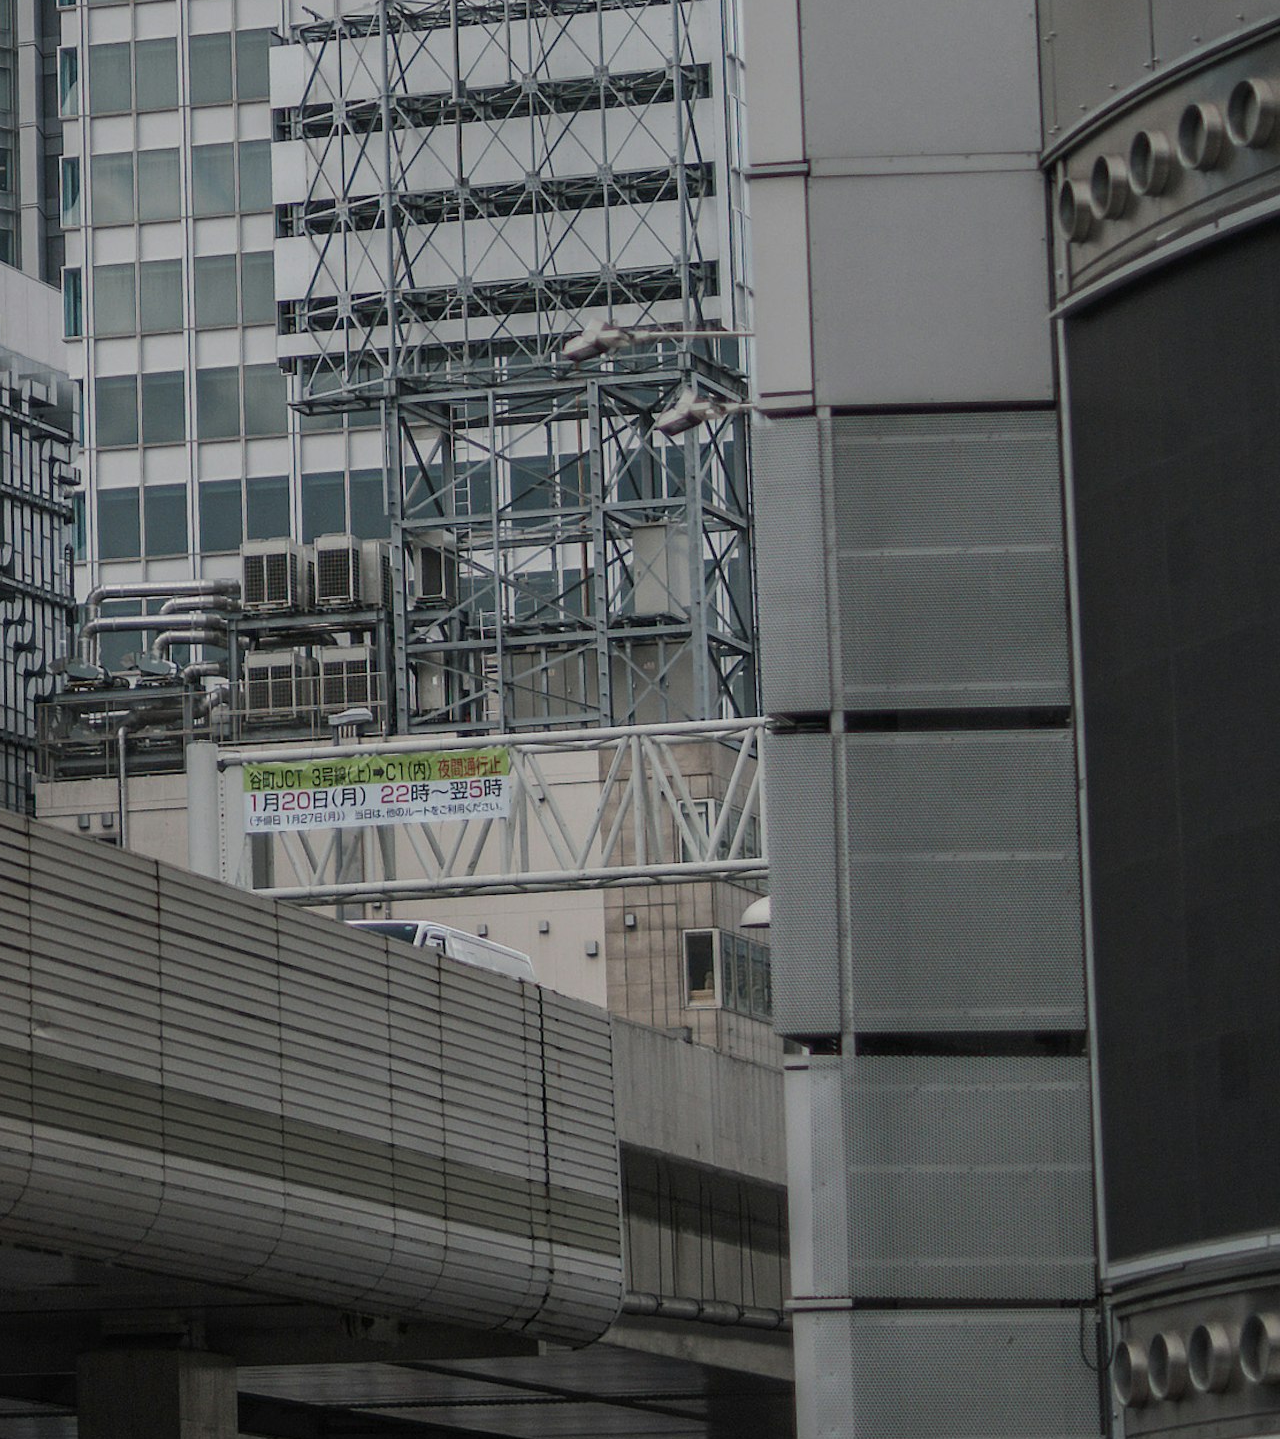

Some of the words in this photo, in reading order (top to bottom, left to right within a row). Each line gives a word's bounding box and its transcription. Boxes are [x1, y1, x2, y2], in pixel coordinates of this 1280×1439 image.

[250, 769, 303, 790] 谷町JCT
[437, 755, 502, 779] 夜間通行止
[250, 786, 366, 812] 1月20日(月)
